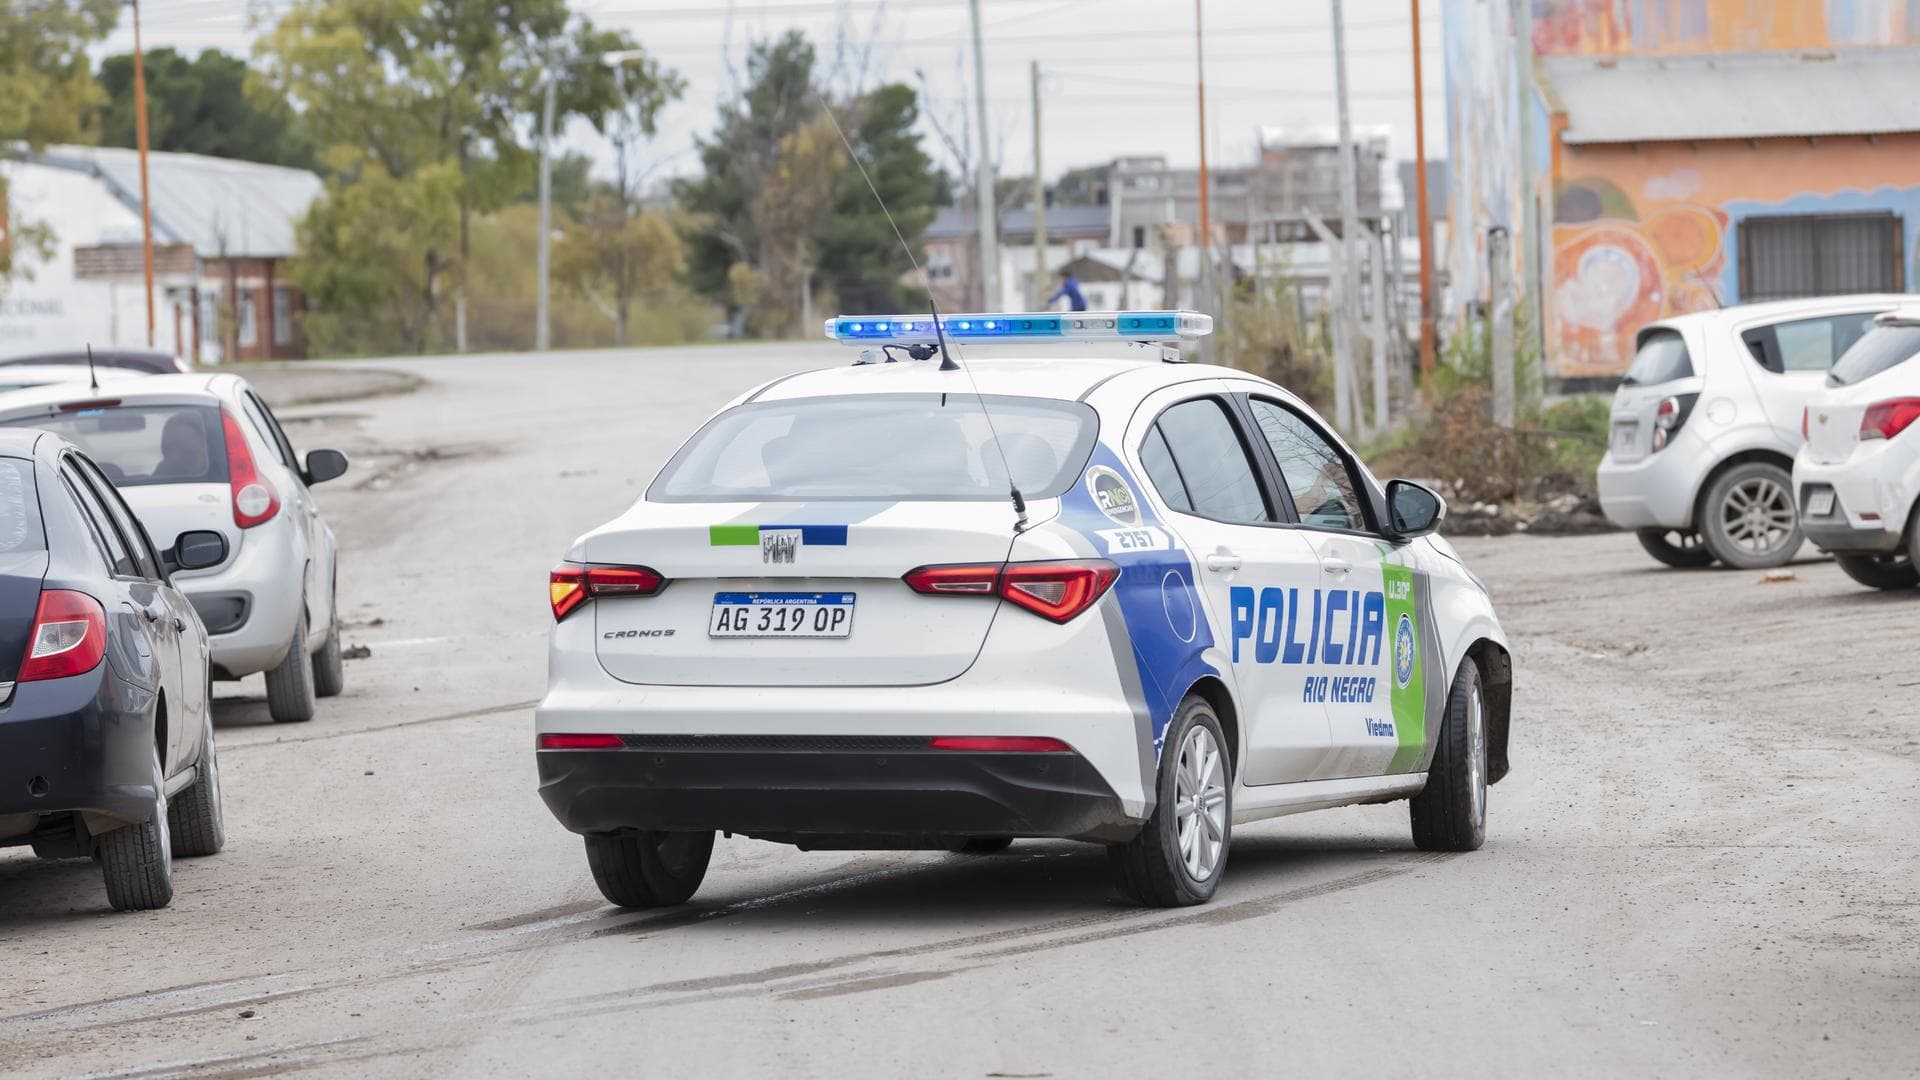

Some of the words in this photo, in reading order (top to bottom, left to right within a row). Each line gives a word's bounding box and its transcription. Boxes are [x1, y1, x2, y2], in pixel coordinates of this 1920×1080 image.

[763, 534, 798, 564] FIAT
[1114, 530, 1154, 549] 2757
[716, 607, 749, 632] AG
[757, 607, 805, 632] 319
[814, 607, 846, 632] OP
[1230, 586, 1384, 666] POLICIA
[604, 629, 676, 640] CRONOS
[1303, 676, 1328, 703] RIO
[1330, 676, 1376, 703] NEGRO
[1365, 717, 1394, 737] Viedma
